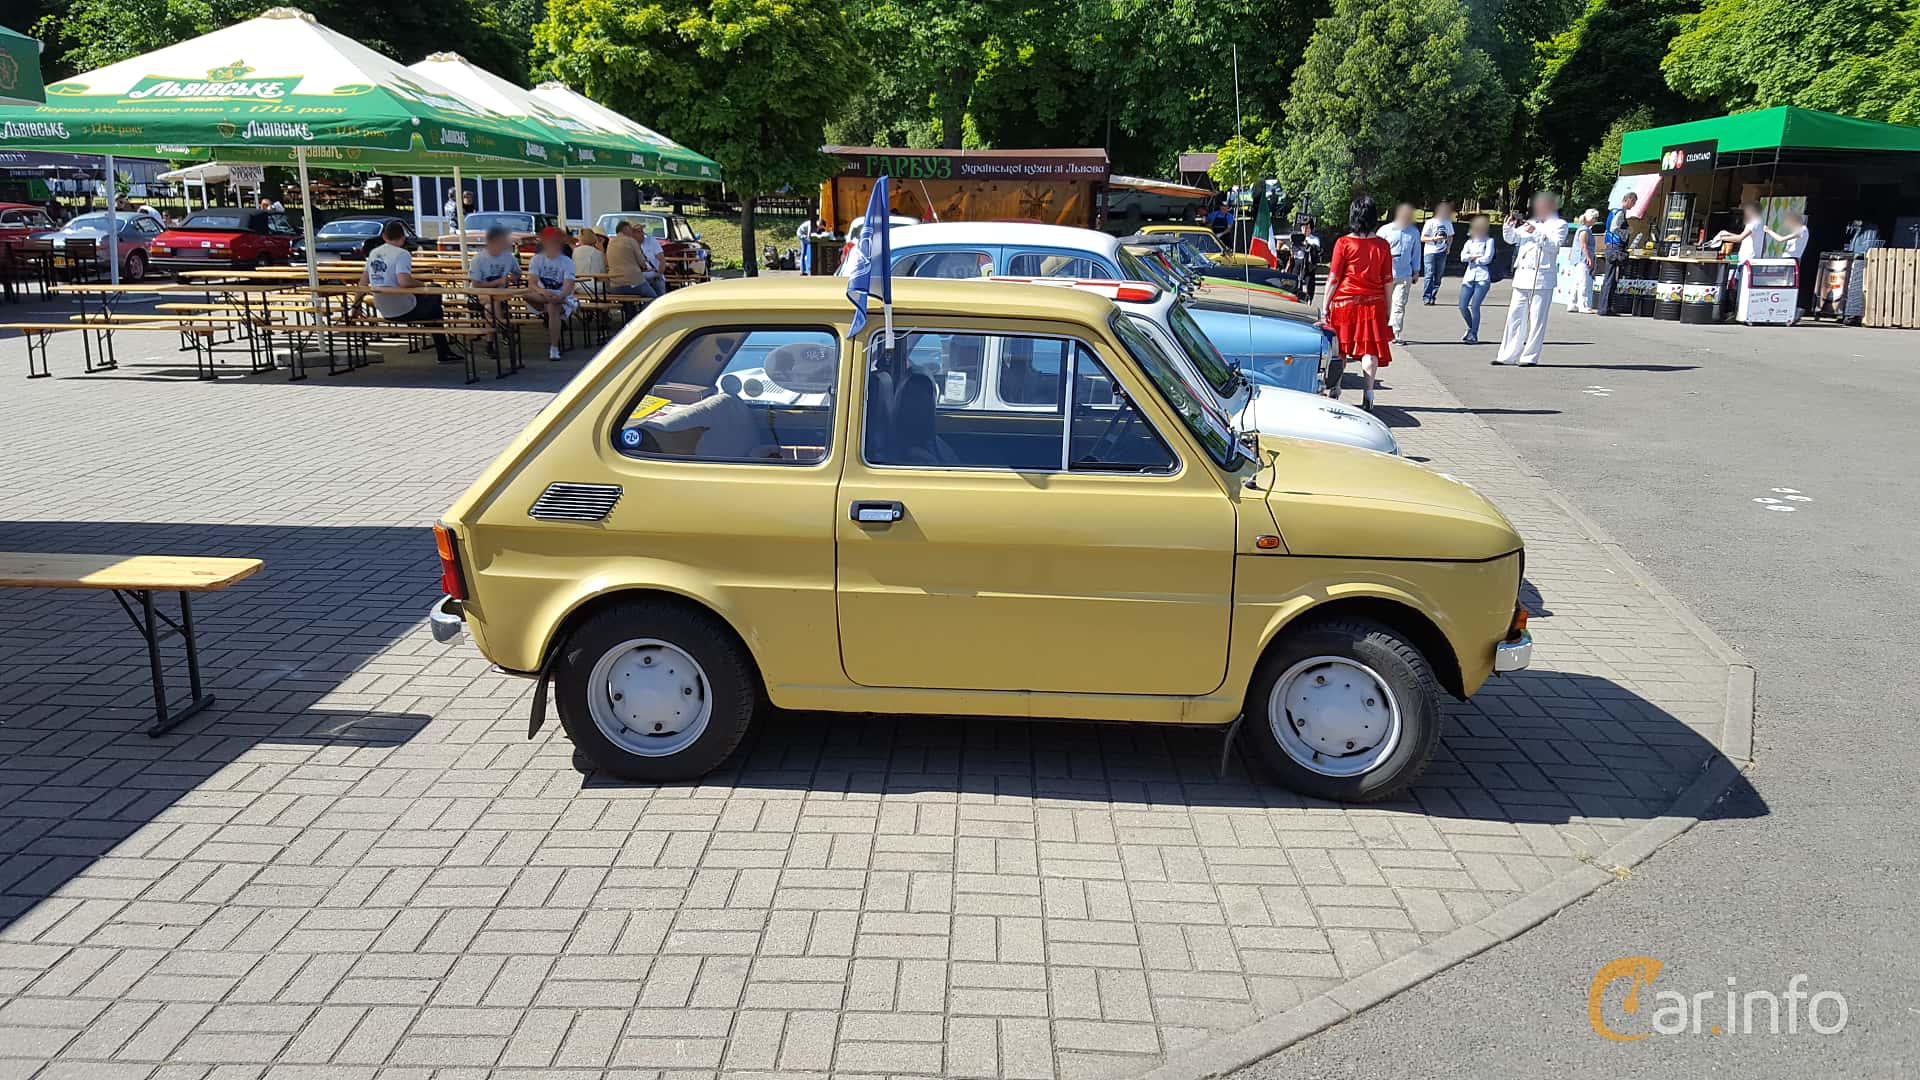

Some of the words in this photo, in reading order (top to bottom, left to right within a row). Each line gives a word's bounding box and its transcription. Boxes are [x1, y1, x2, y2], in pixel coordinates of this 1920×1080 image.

[128, 81, 285, 99] ЛЬВІВСЬКЕ
[248, 104, 296, 114] 1715
[297, 105, 347, 115] року
[242, 119, 314, 141] ЛЬВІВСЬКЕ
[865, 156, 953, 179] ГАРБУЗ
